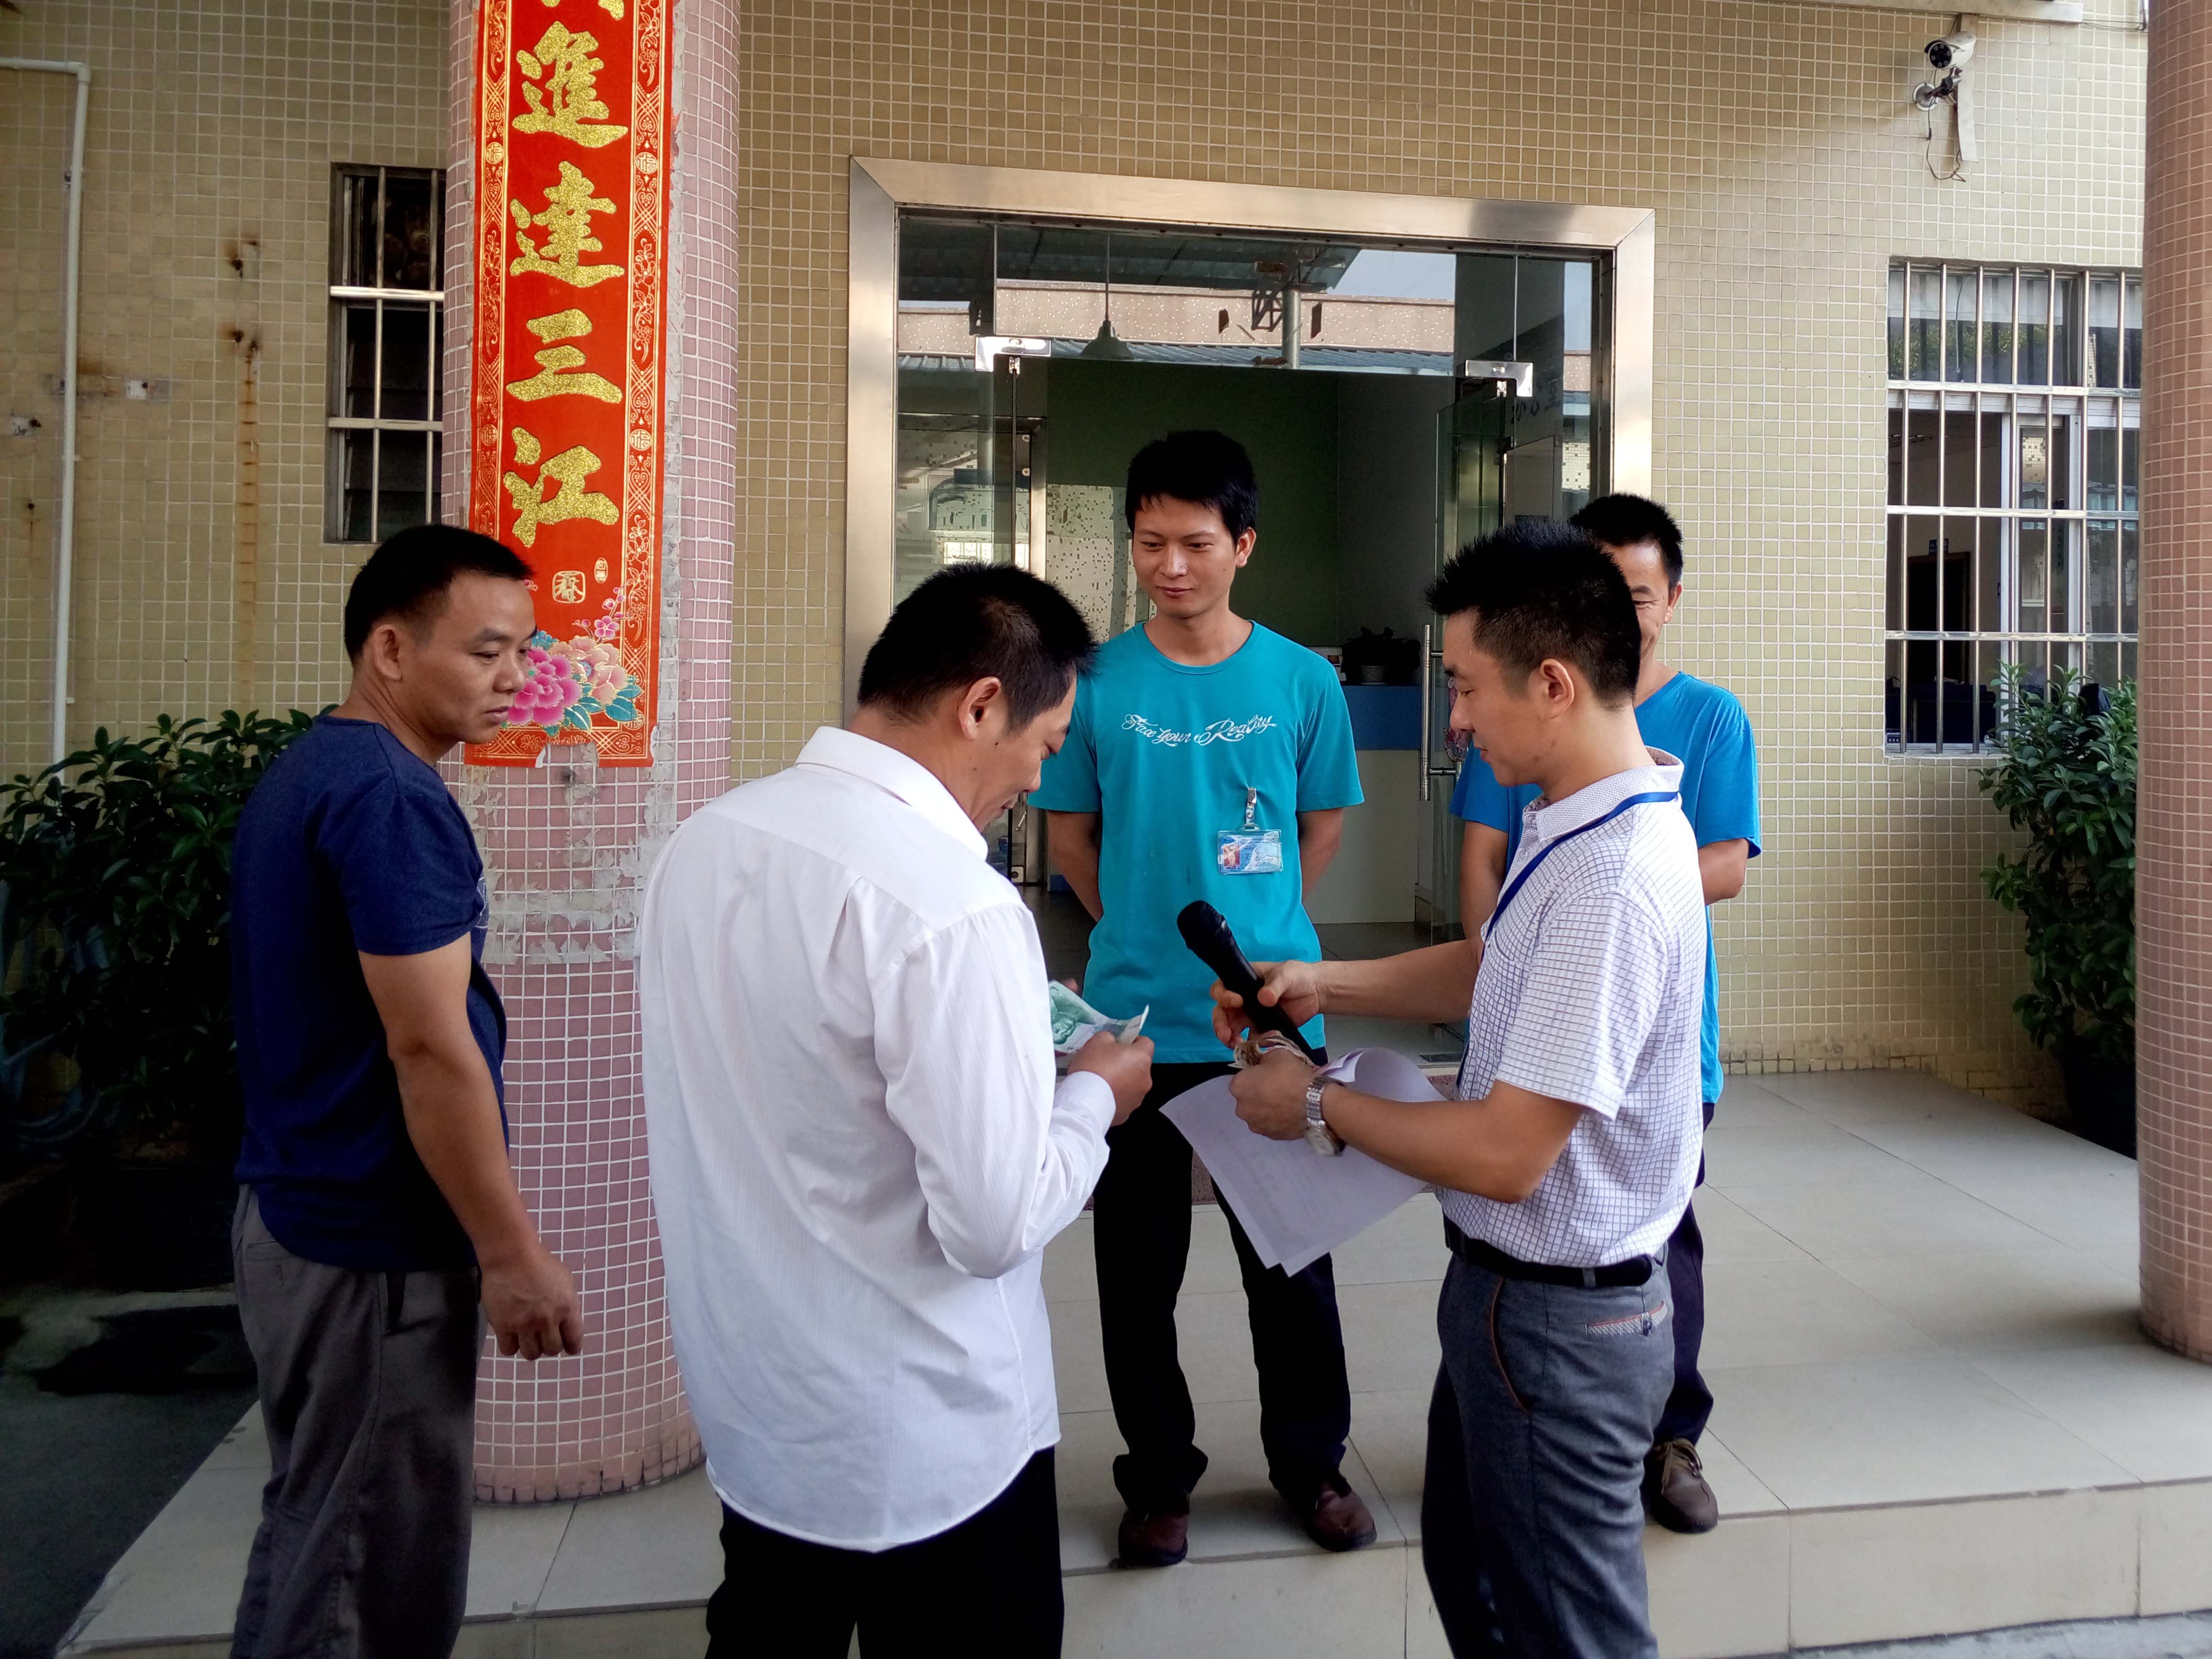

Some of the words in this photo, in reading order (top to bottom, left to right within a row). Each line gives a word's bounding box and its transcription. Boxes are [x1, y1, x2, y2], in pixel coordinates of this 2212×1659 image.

[485, 142, 503, 164] 福
[635, 152, 657, 174] 福
[503, 0, 629, 547] 進達三江
[629, 429, 652, 451] 福
[1121, 714, 1158, 738] Face
[1151, 728, 1191, 746] Your
[1194, 715, 1277, 746] Reality
